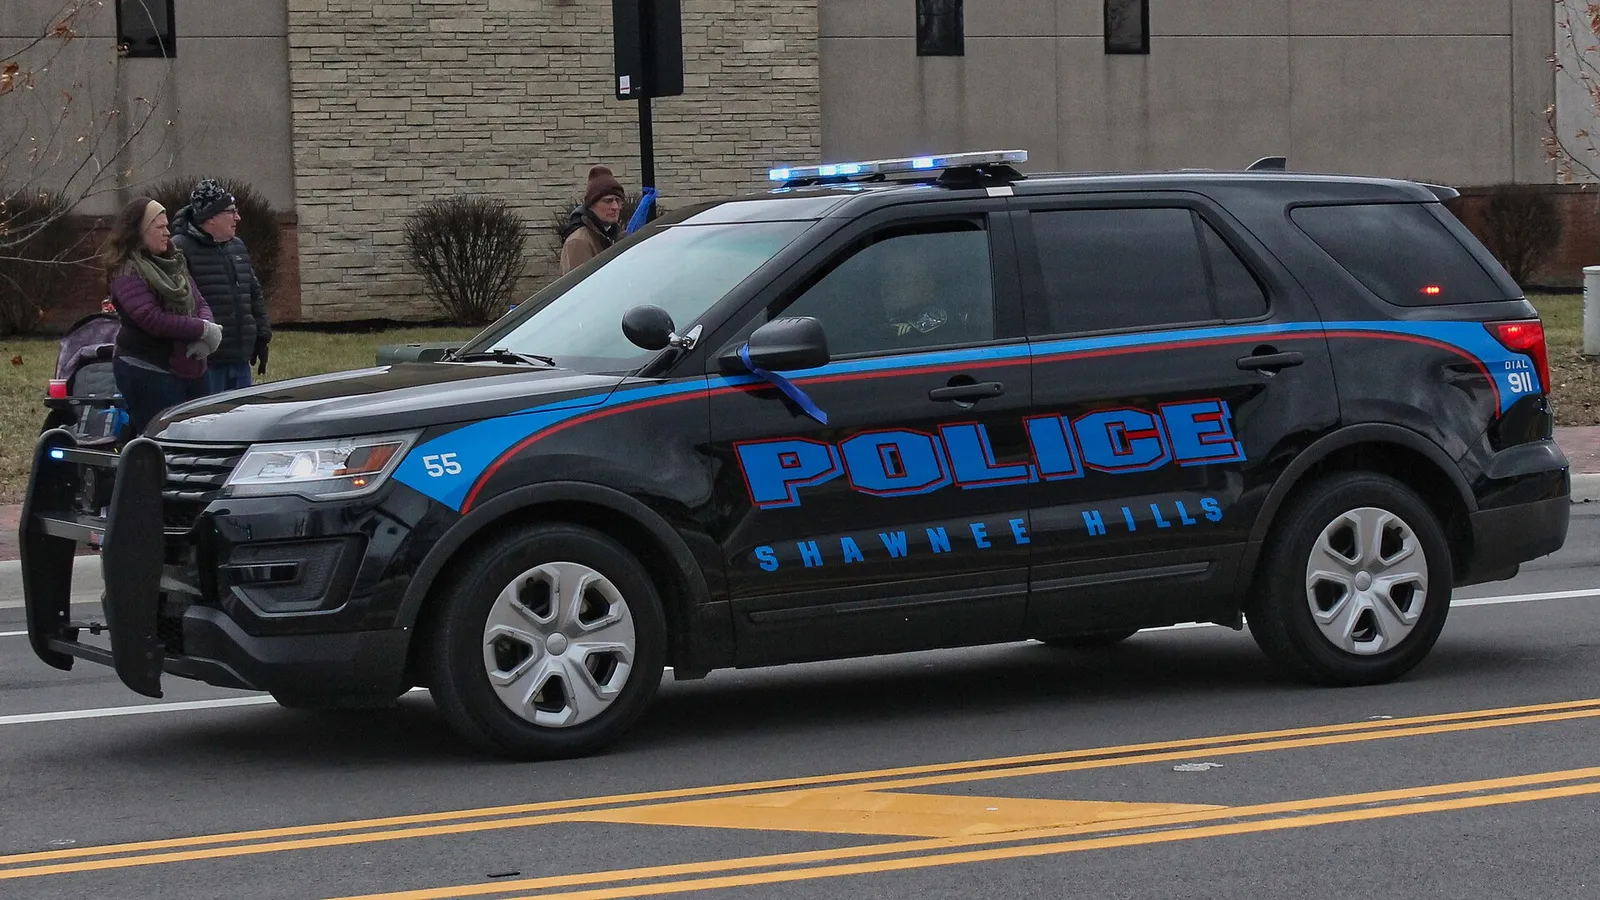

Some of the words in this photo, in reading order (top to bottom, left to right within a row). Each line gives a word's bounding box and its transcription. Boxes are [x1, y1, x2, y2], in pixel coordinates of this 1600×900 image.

[1505, 360, 1528, 370] DIAL
[1508, 372, 1532, 393] 911
[423, 453, 462, 477] 55
[734, 398, 1247, 510] POLICE
[754, 517, 1031, 572] SHAWNEE
[1081, 497, 1223, 536] HILLS
